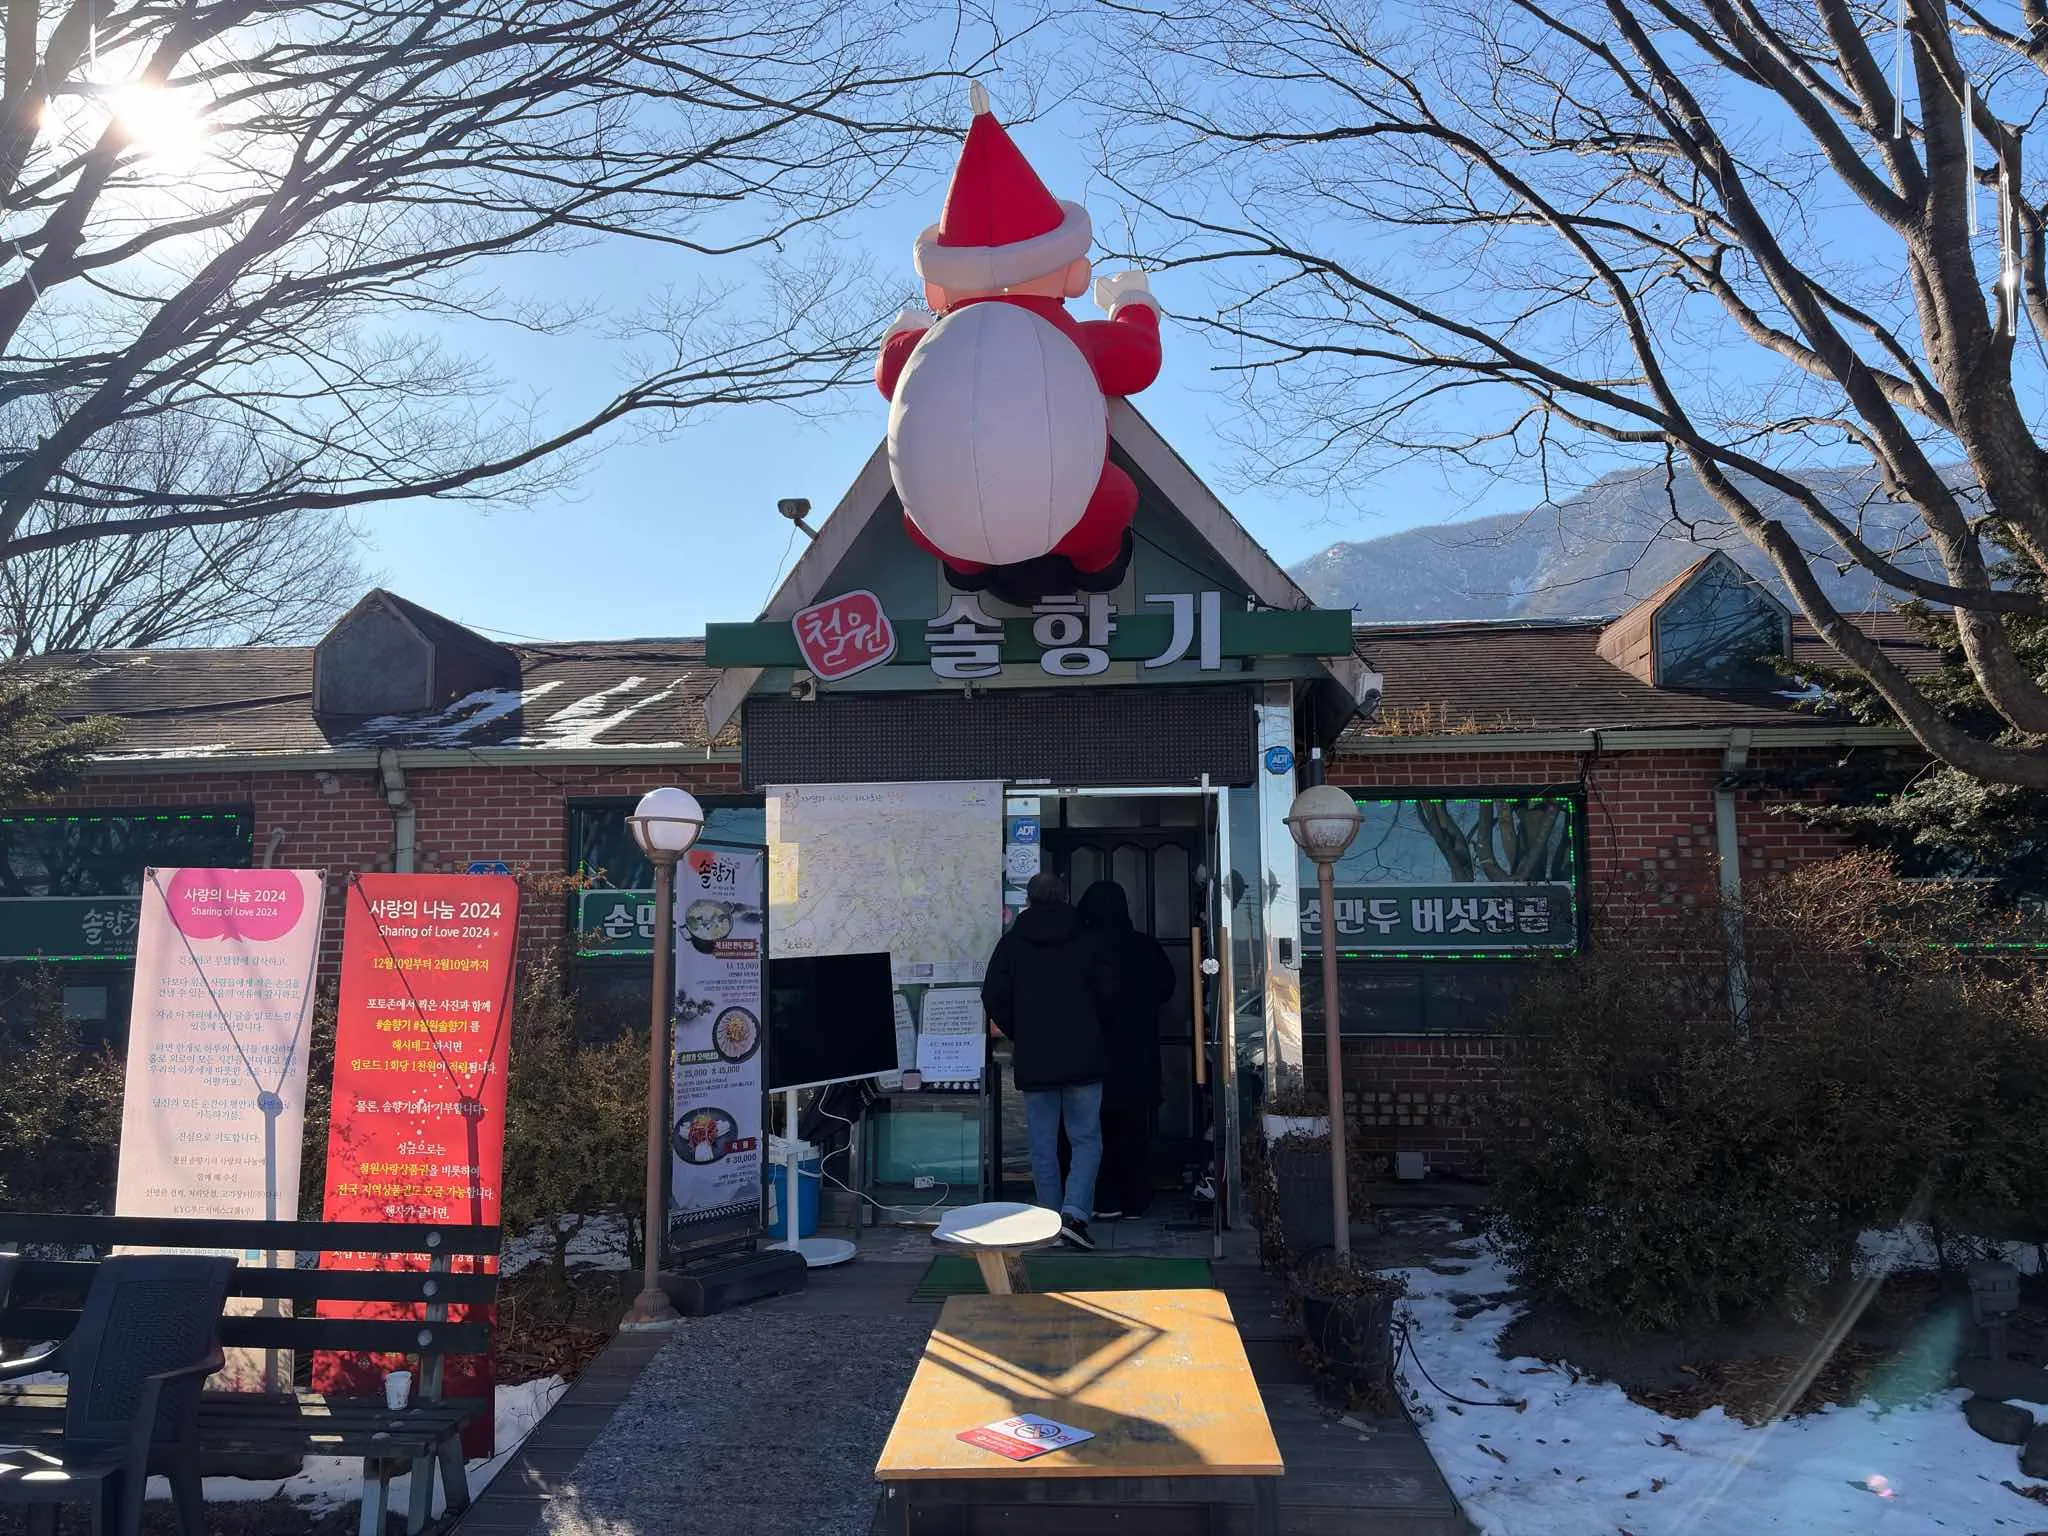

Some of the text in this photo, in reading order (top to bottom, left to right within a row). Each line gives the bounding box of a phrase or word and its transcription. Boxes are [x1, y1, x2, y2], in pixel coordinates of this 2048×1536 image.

[803, 607, 888, 667] 철원
[924, 591, 1221, 679] 솔향기
[1016, 825, 1036, 836] ADT
[698, 859, 736, 889] 솔향기
[184, 888, 287, 903] 사랑의 나눔 2024
[191, 906, 278, 917] Sharing of Love 2024
[370, 899, 502, 920] 사랑의 나눔 2024
[1301, 896, 1550, 935] 손만두 버섯전골
[379, 925, 490, 939] Sharing of Love 2024
[434, 959, 489, 971] 2월10일까지
[366, 999, 415, 1011] 포토존에서
[440, 1000, 469, 1012] 사진과
[472, 1000, 491, 1012] 함께
[376, 1020, 411, 1032] #솔향기
[413, 1021, 467, 1033] #철원솔향기
[433, 1040, 464, 1052] 하시면
[351, 1060, 382, 1071] 업로드
[384, 1061, 409, 1072] 1회당
[412, 1061, 446, 1072] 1천원이
[356, 1100, 380, 1113] 물론,
[397, 1143, 447, 1155] 성금으로는
[359, 1162, 481, 1177] 철원사랑상품권을 비롯하여
[337, 1184, 360, 1197] 전국
[424, 1185, 444, 1197] 모금
[447, 1186, 495, 1200] 가능합니다.
[385, 1206, 450, 1219] 행사가 끝나면,
